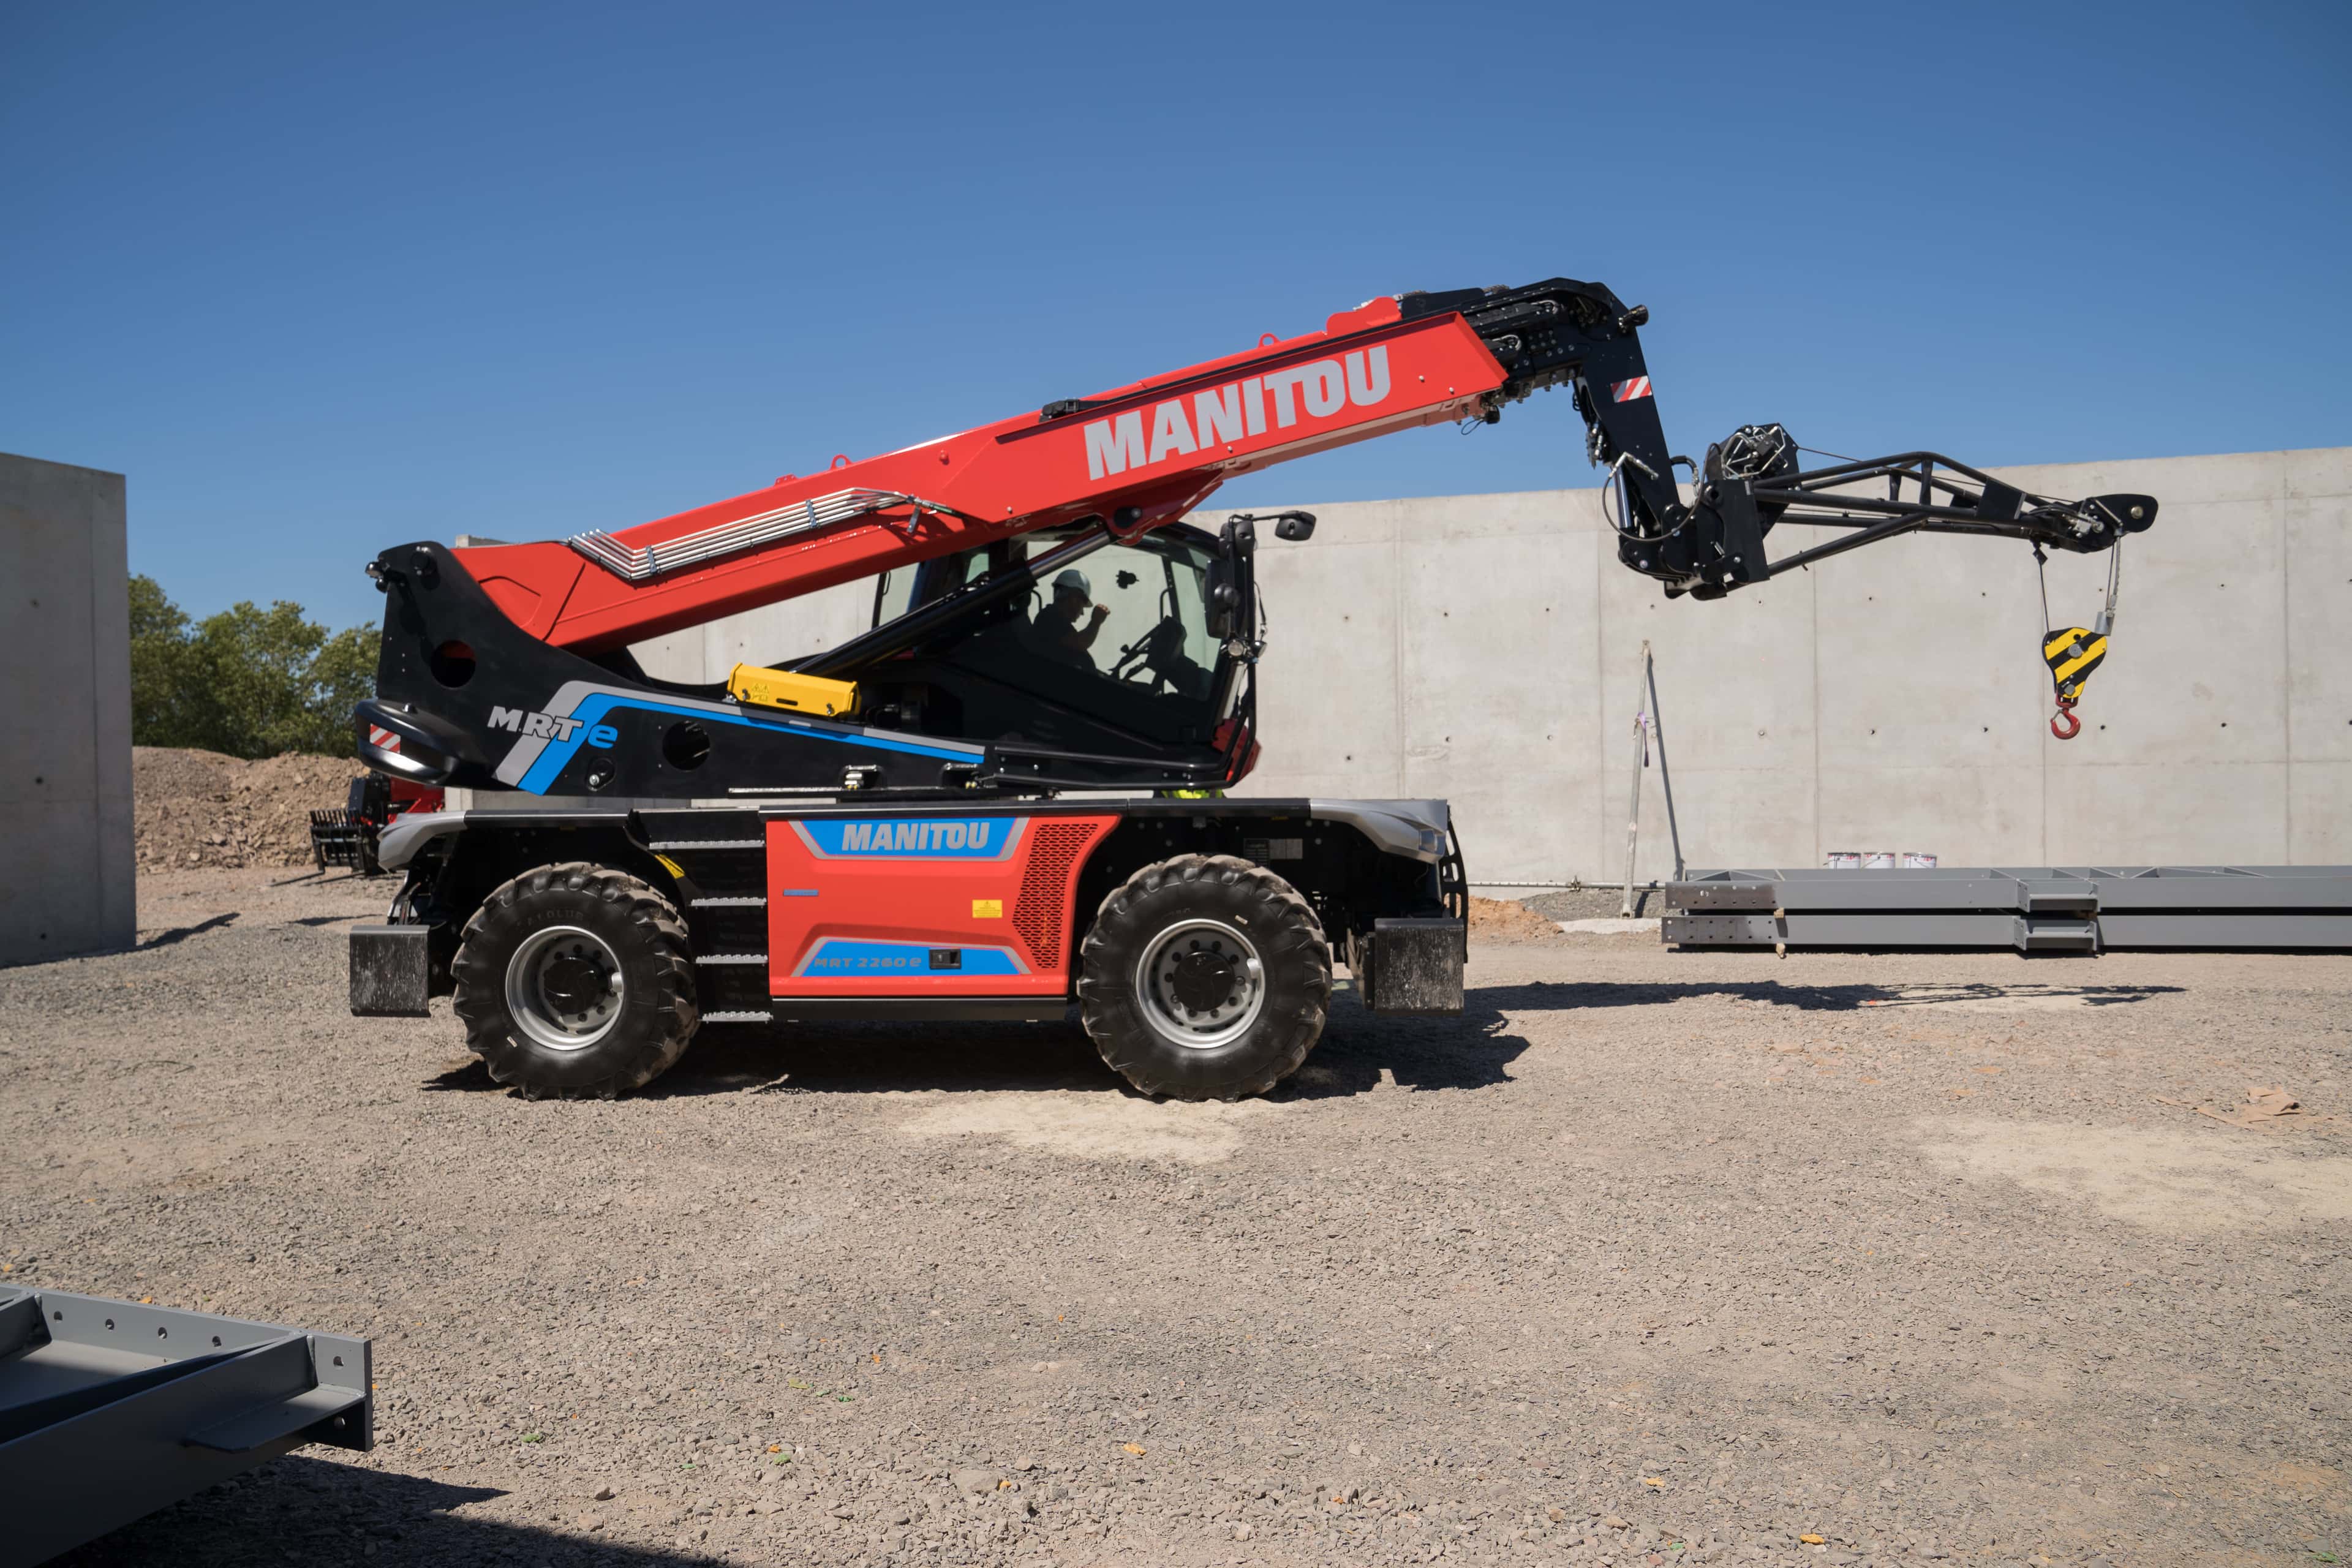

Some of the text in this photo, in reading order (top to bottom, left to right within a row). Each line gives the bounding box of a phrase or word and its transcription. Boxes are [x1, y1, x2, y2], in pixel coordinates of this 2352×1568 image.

[1084, 345, 1390, 481] MANITOU
[842, 823, 990, 851] MANITOU
[813, 958, 853, 967] MRT
[858, 957, 906, 967] 2260
